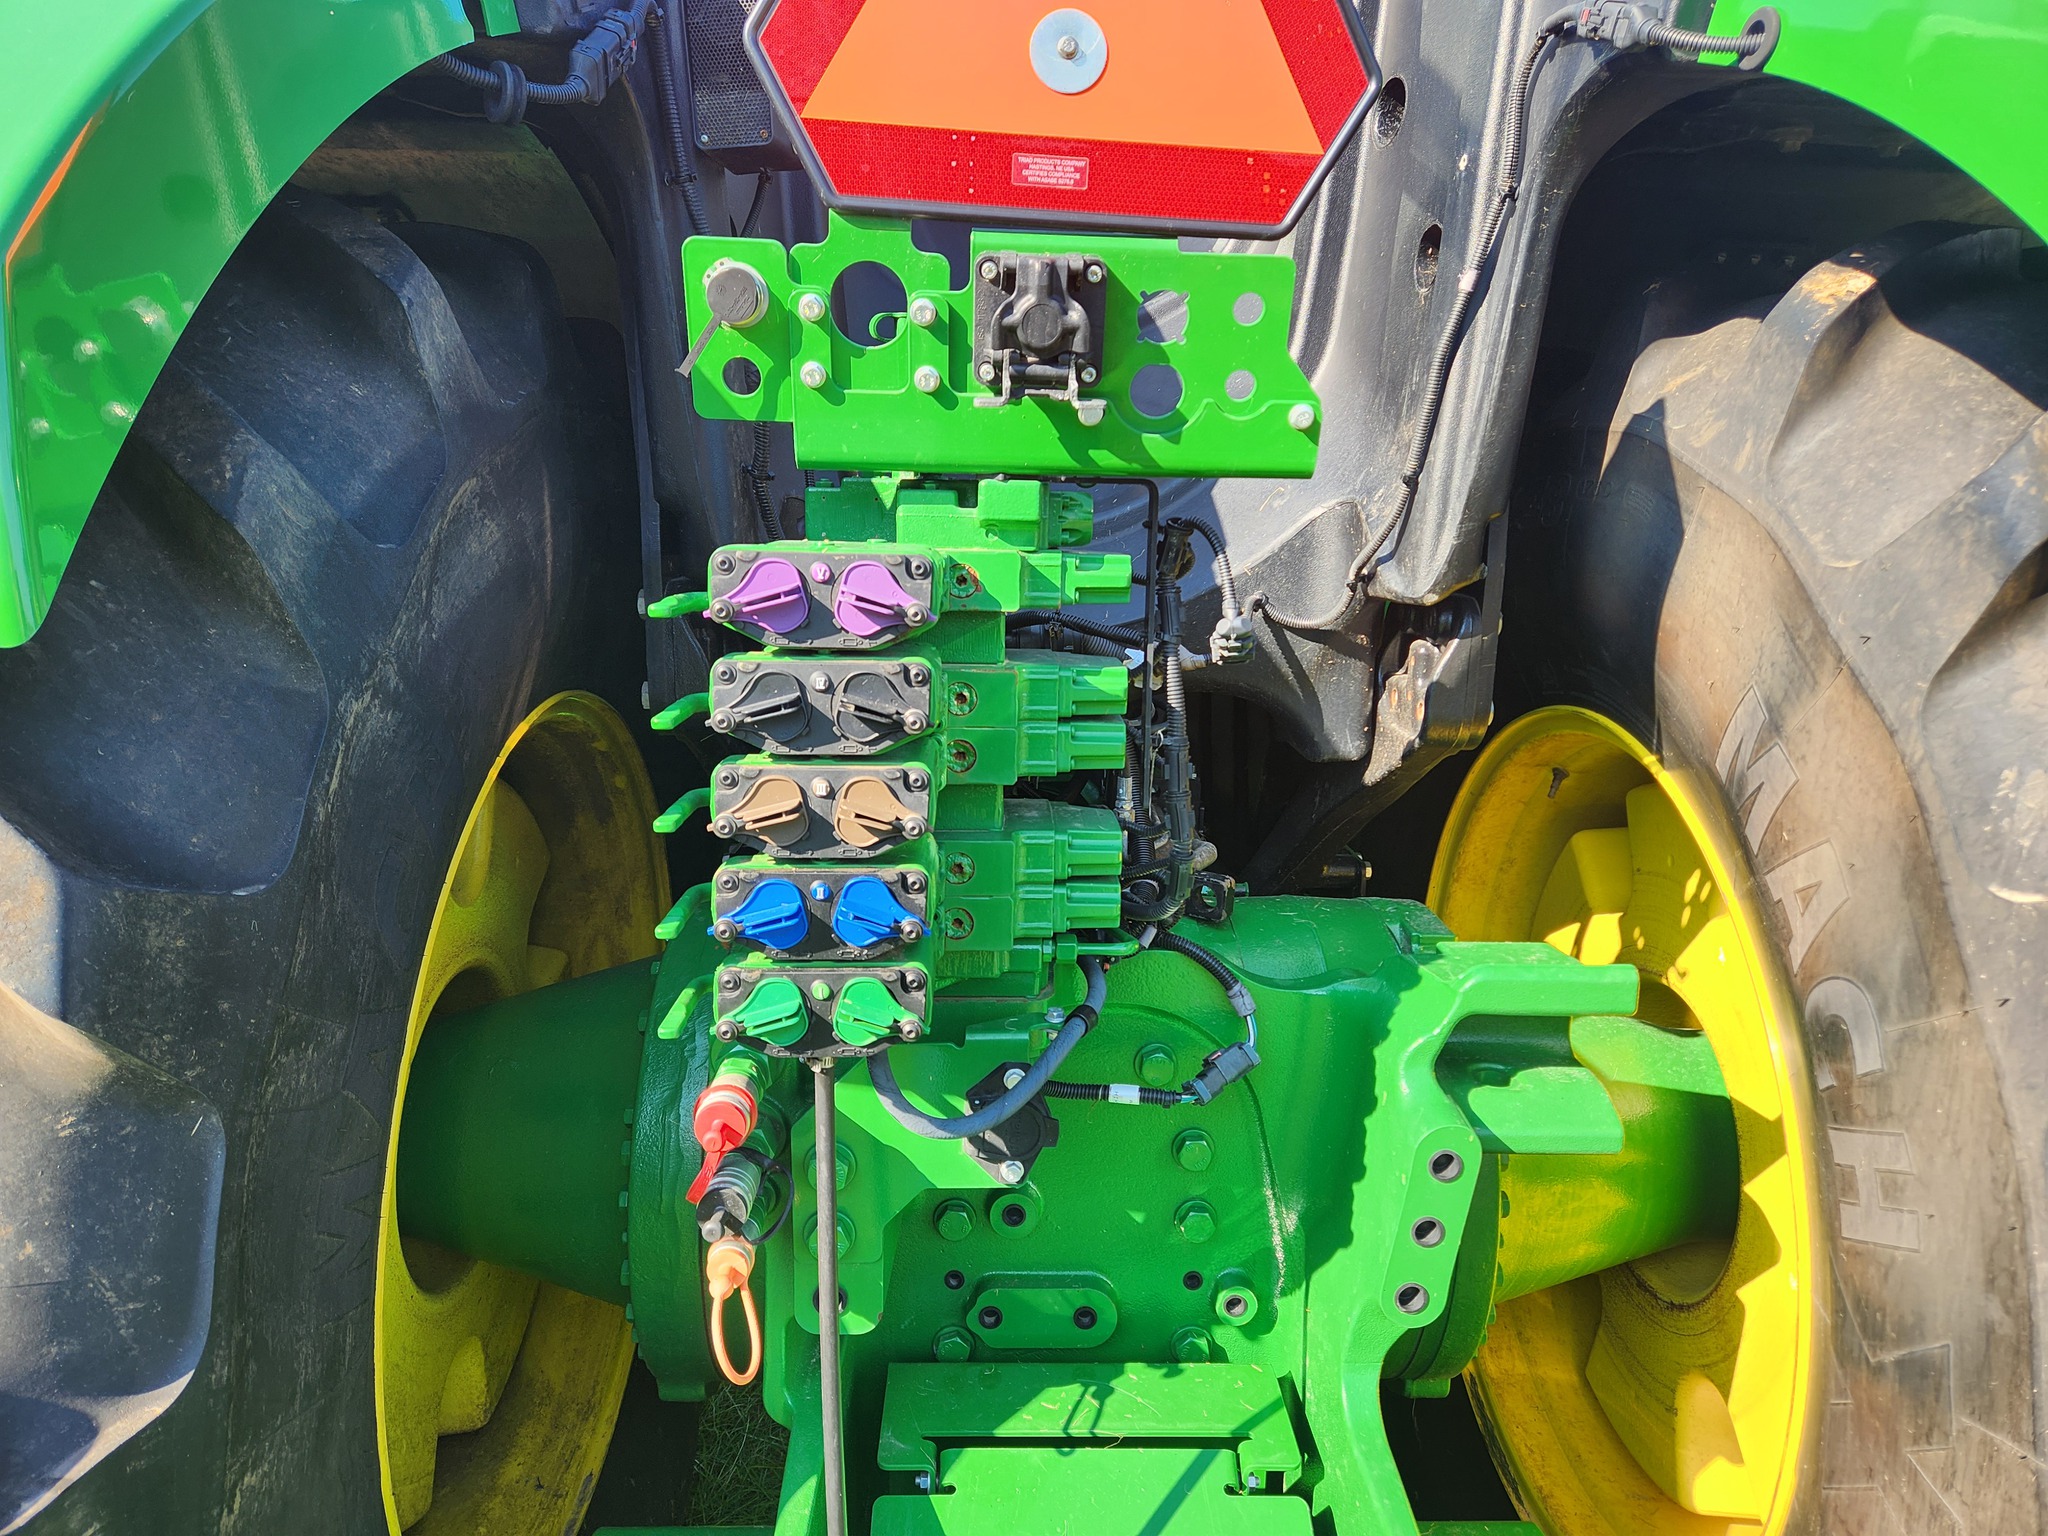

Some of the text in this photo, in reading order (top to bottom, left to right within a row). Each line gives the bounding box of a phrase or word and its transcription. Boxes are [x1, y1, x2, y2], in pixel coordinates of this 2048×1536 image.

[1033, 157, 1061, 165] PRODUCTS
[1022, 169, 1080, 179] CERTIFIES COMPLIANCE
[815, 567, 826, 579] V
[815, 677, 826, 689] IV
[816, 783, 828, 795] III
[816, 887, 825, 900] II
